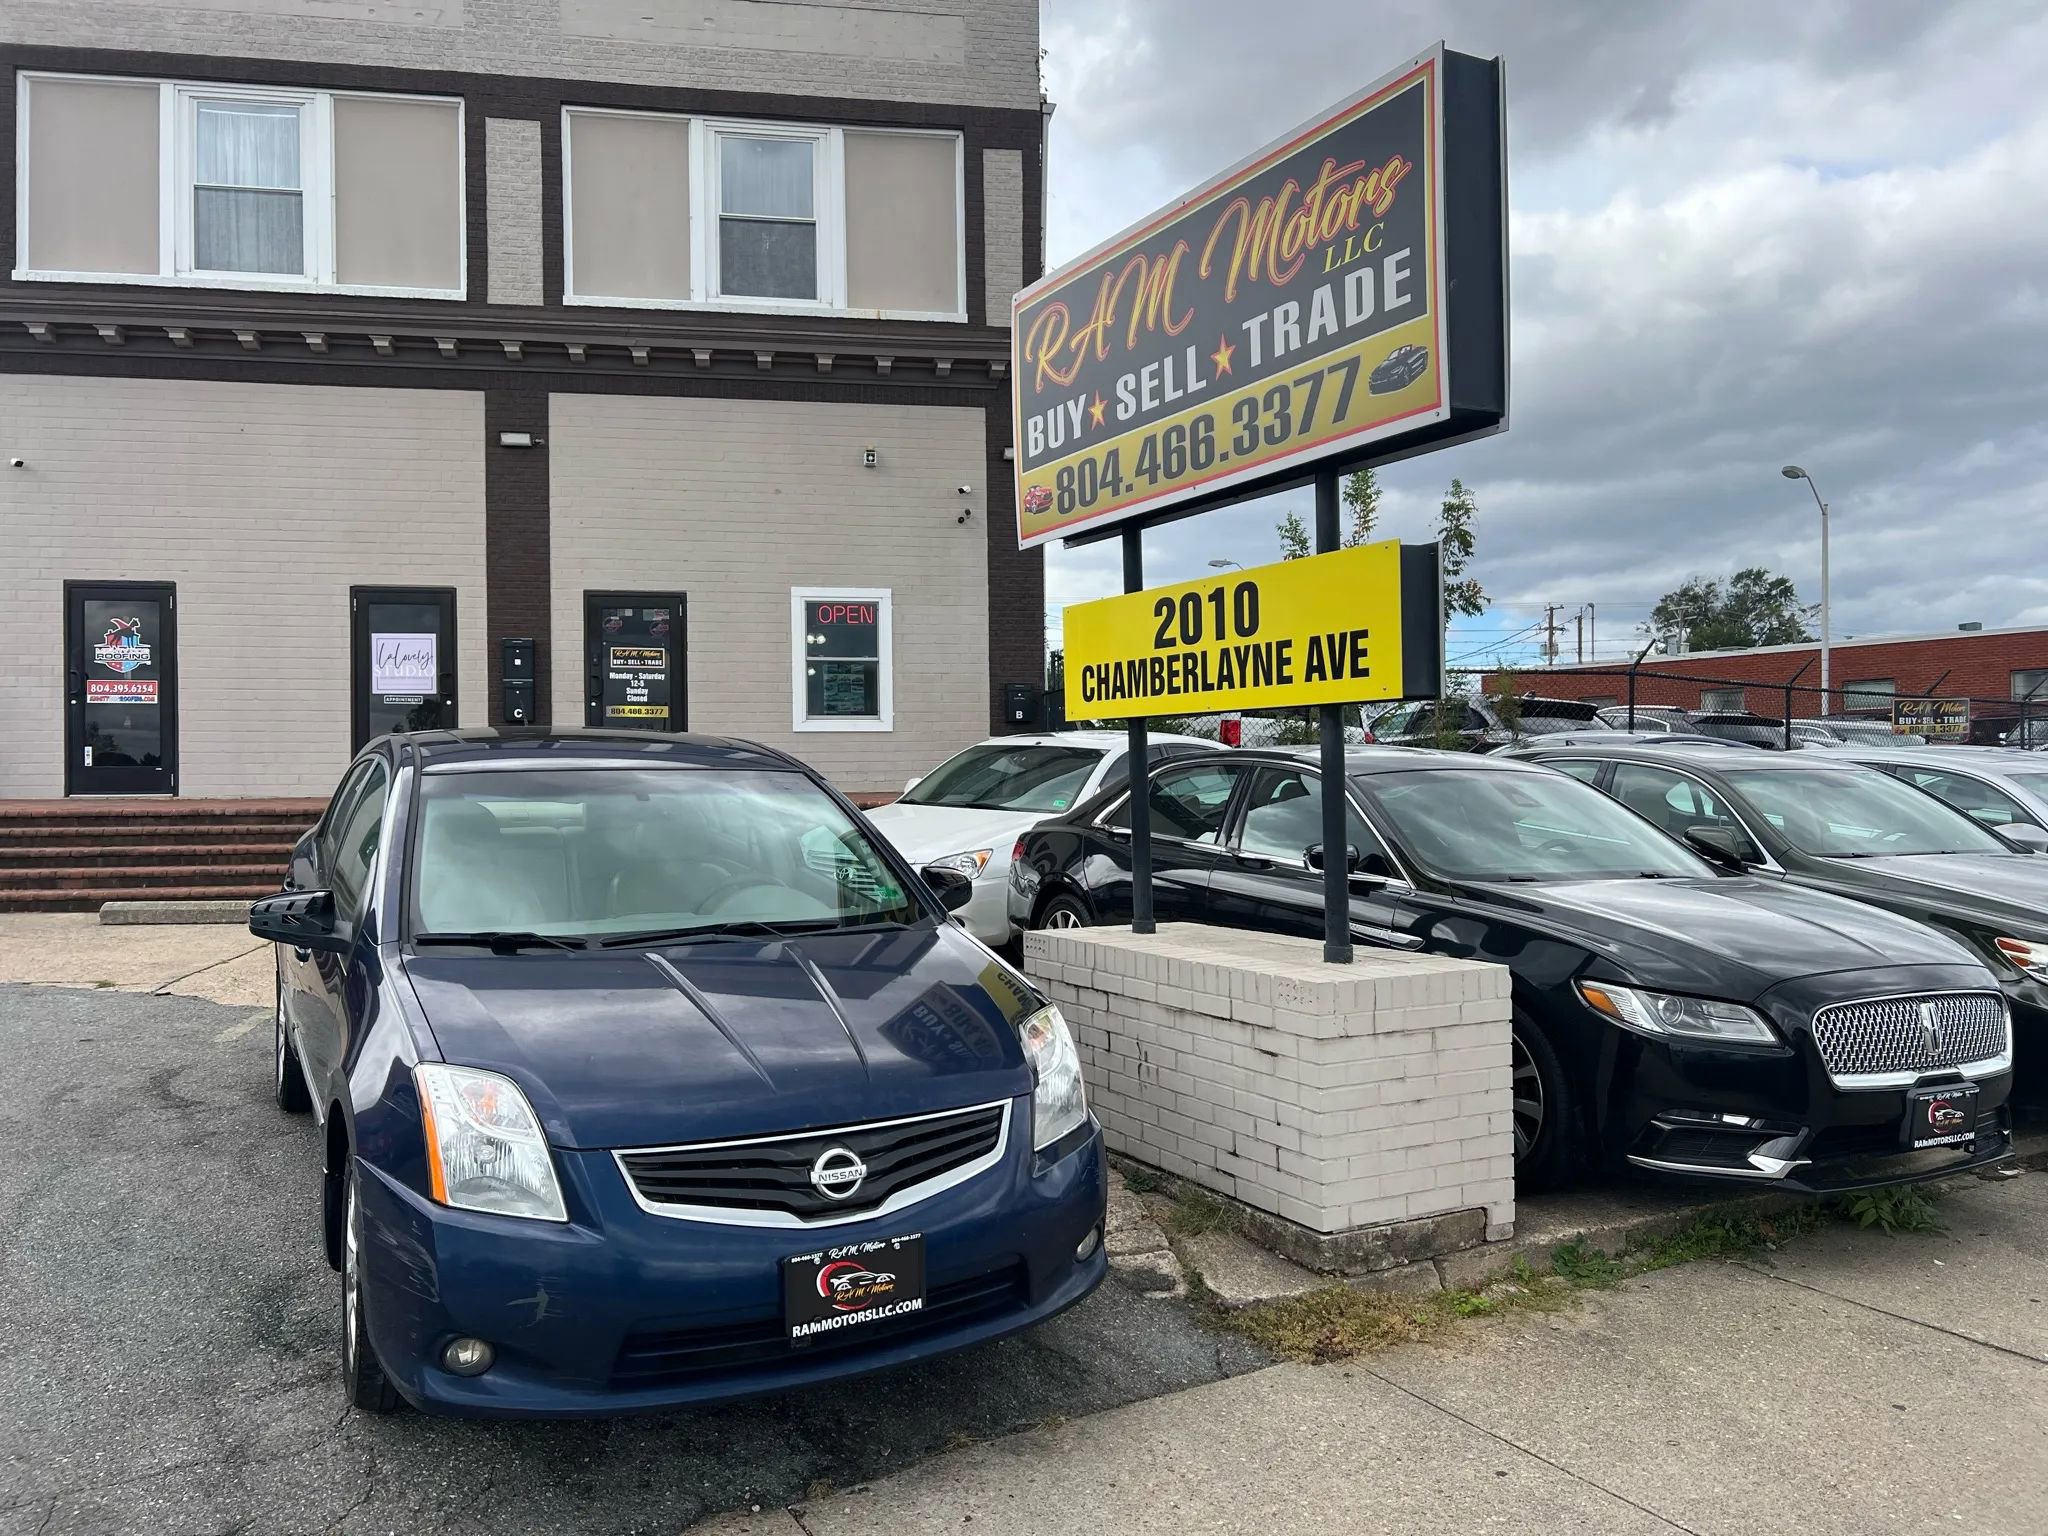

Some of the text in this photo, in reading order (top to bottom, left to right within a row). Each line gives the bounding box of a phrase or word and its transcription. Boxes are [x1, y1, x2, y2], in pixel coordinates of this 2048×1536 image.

[1322, 222, 1384, 274] LLC
[1025, 155, 1412, 393] RAM Motors
[1028, 247, 1412, 458] BUY SELL TRADE
[1056, 355, 1361, 515] 804.466.3377
[818, 604, 874, 625] OPEN
[1154, 581, 1260, 650] 2010
[1082, 629, 1370, 703] CHAMBERLAYNE AVE
[609, 672, 634, 680] Monday
[638, 672, 665, 680] Saturday
[90, 684, 153, 693] 804.395.6254
[625, 687, 649, 695] Sunday
[513, 708, 523, 718] C
[1015, 710, 1024, 719] B
[818, 1168, 863, 1182] NISSAN
[828, 1245, 859, 1259] RAM
[834, 1286, 865, 1301] RAM
